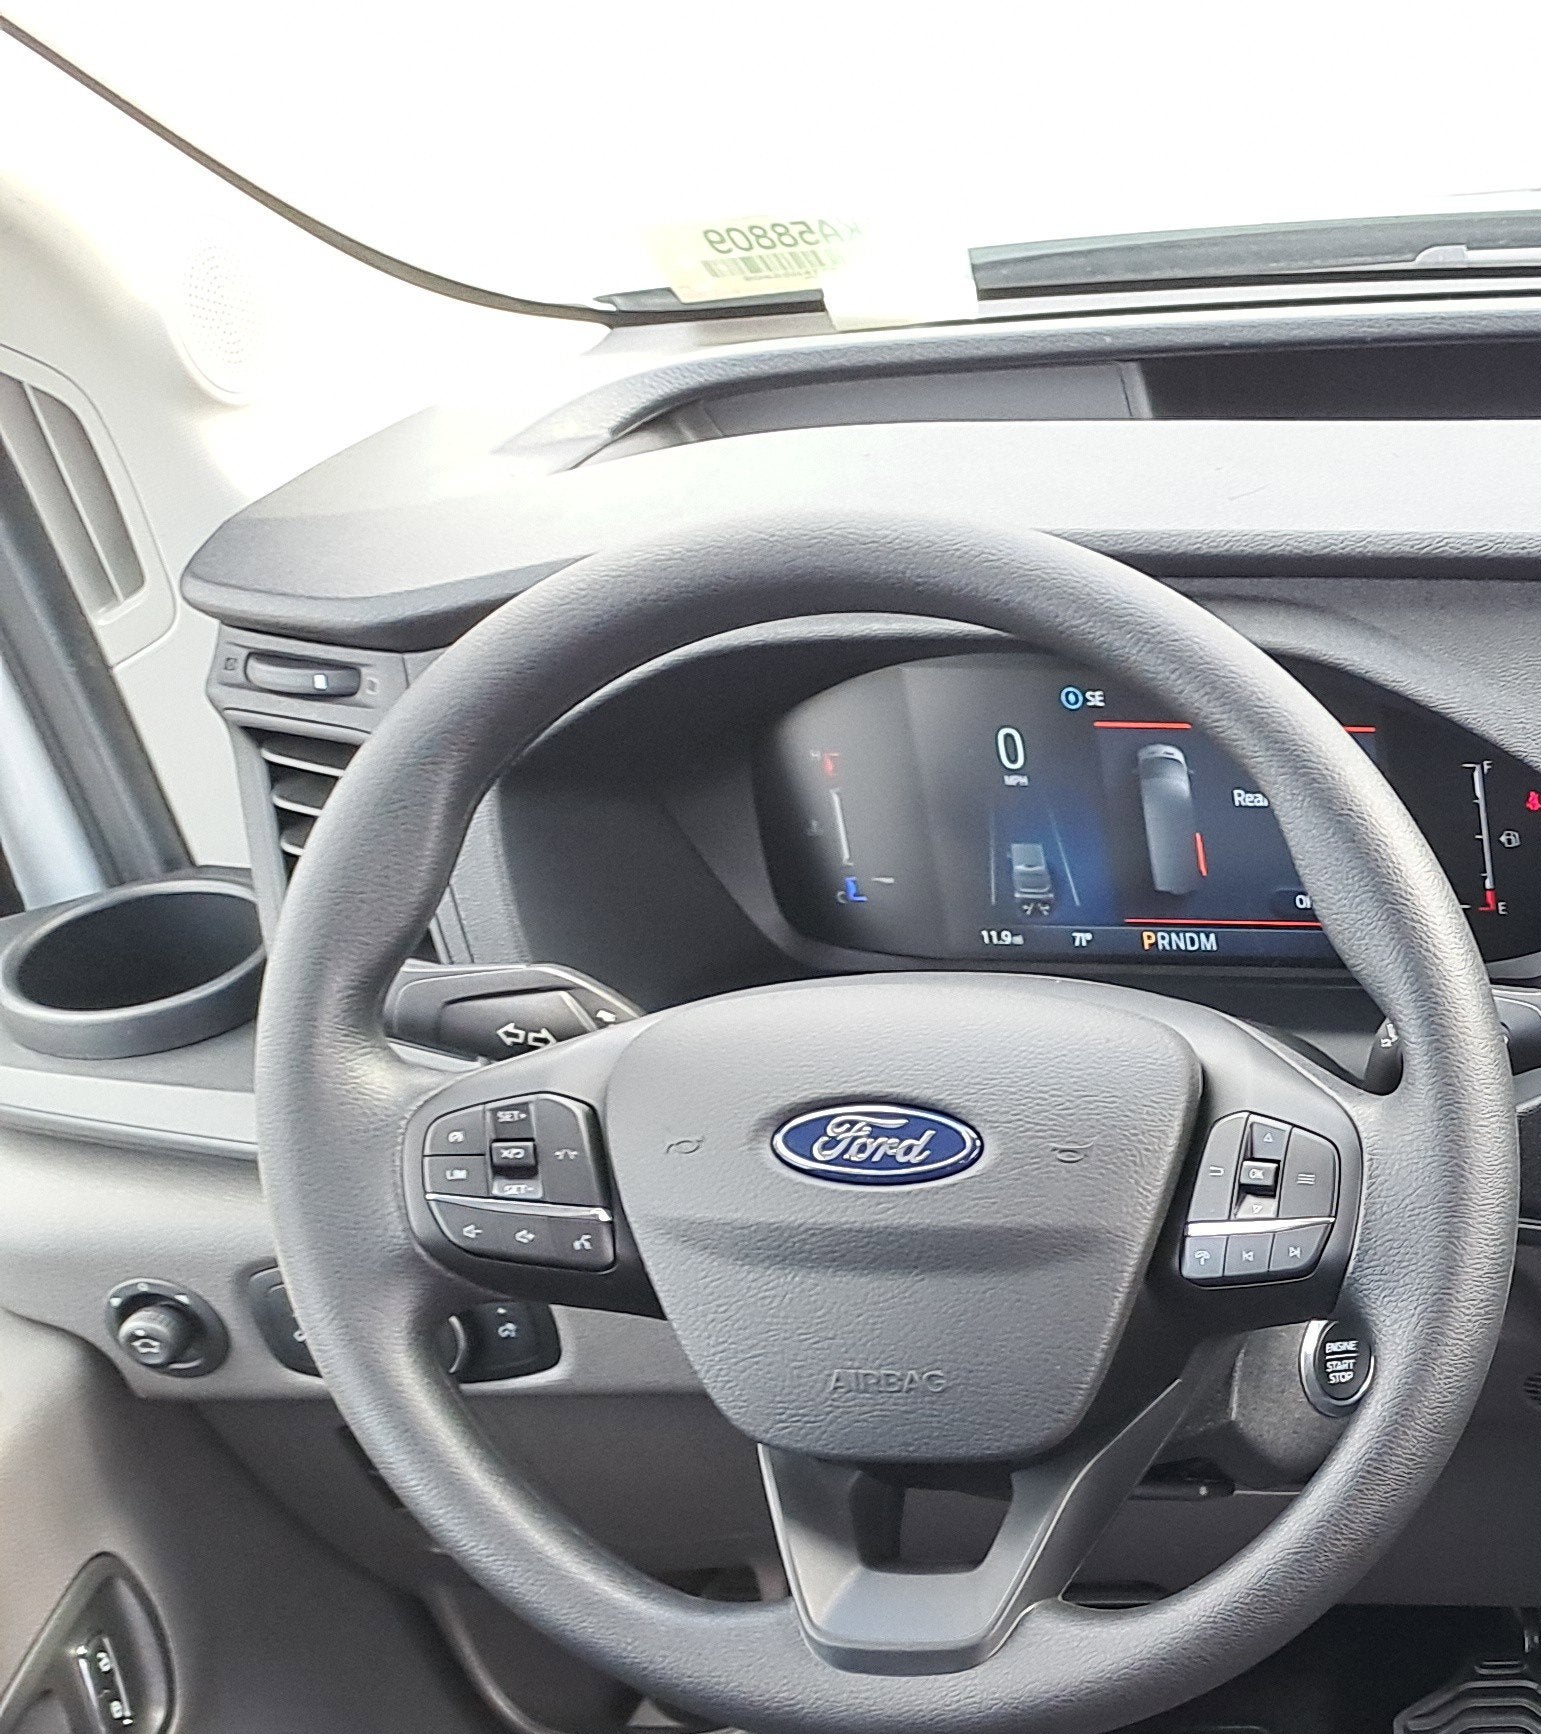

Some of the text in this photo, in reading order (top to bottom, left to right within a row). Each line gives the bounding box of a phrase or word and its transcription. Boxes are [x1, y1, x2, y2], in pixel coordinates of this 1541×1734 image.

[997, 727, 1025, 770] 0
[1483, 760, 1493, 775] F
[1498, 901, 1508, 915] E
[811, 1114, 937, 1165] Ford
[1248, 1167, 1265, 1180] OK
[1325, 1341, 1359, 1354] ENGINE
[1325, 1358, 1357, 1373] START
[829, 1368, 948, 1393] AIRBAG
[1328, 1370, 1354, 1384] STOP
